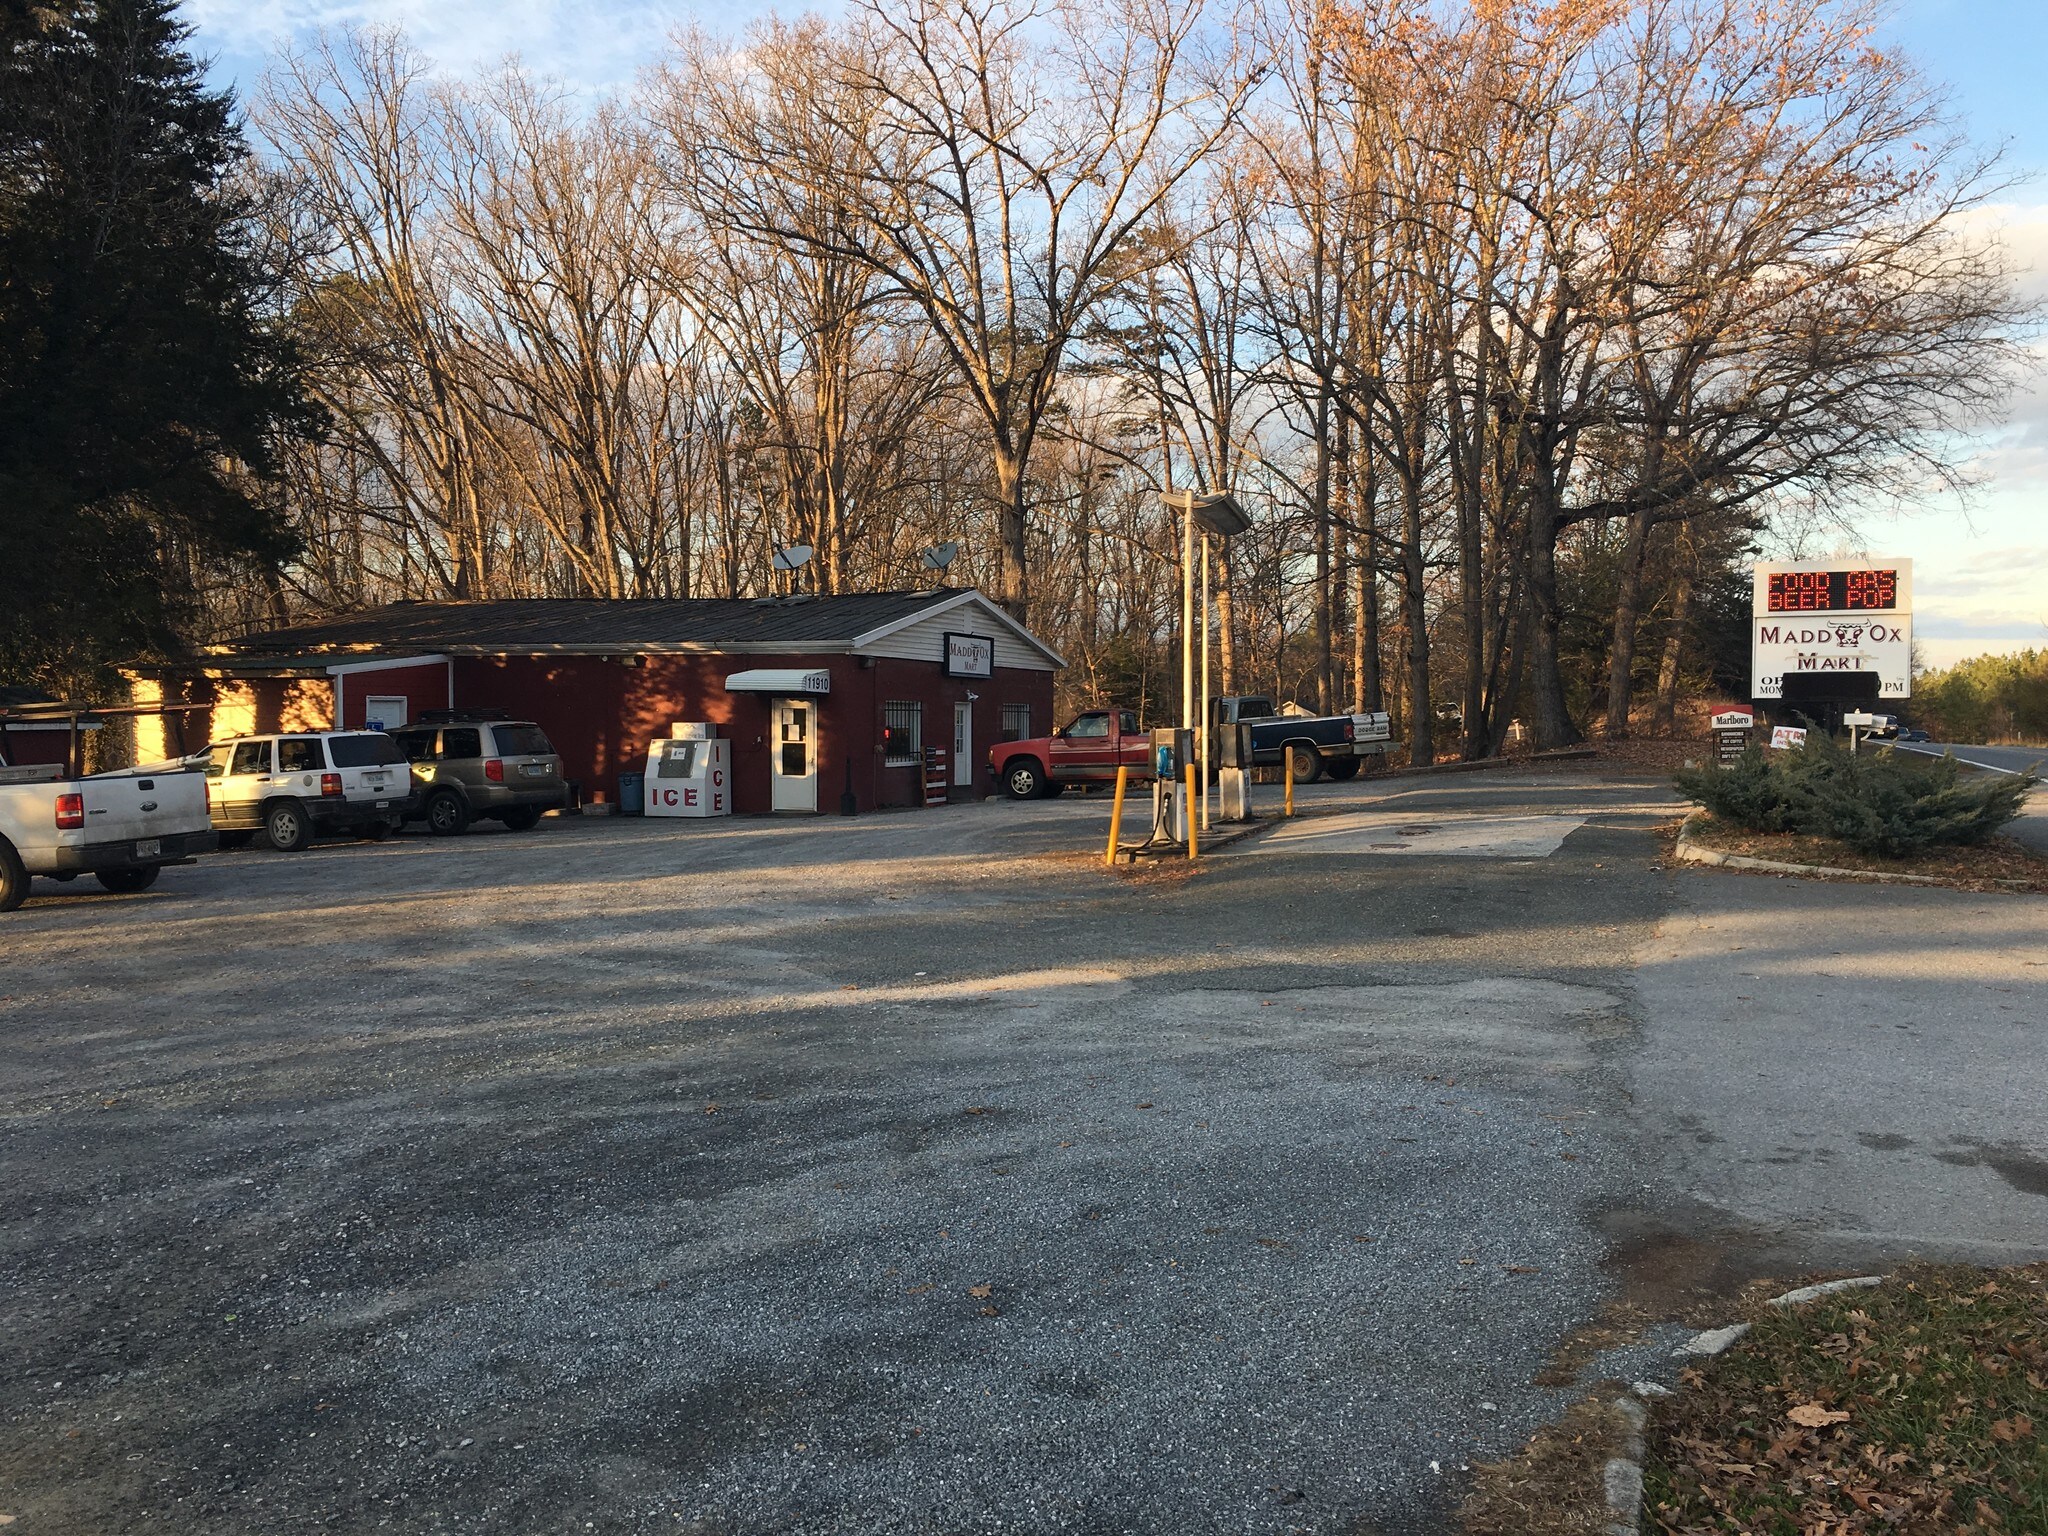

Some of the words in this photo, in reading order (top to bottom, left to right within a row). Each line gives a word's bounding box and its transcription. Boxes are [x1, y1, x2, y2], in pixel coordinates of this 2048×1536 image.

[1769, 572, 1830, 591] FOOD
[1847, 570, 1894, 589] GAS
[1769, 591, 1830, 609] BEER
[1847, 589, 1894, 608] POP
[964, 661, 977, 671] MART
[807, 677, 829, 690] 11910
[1884, 682, 1904, 691] PM
[1716, 715, 1749, 724] Marlboro
[713, 746, 723, 811] ICE
[652, 788, 698, 807] ICE
